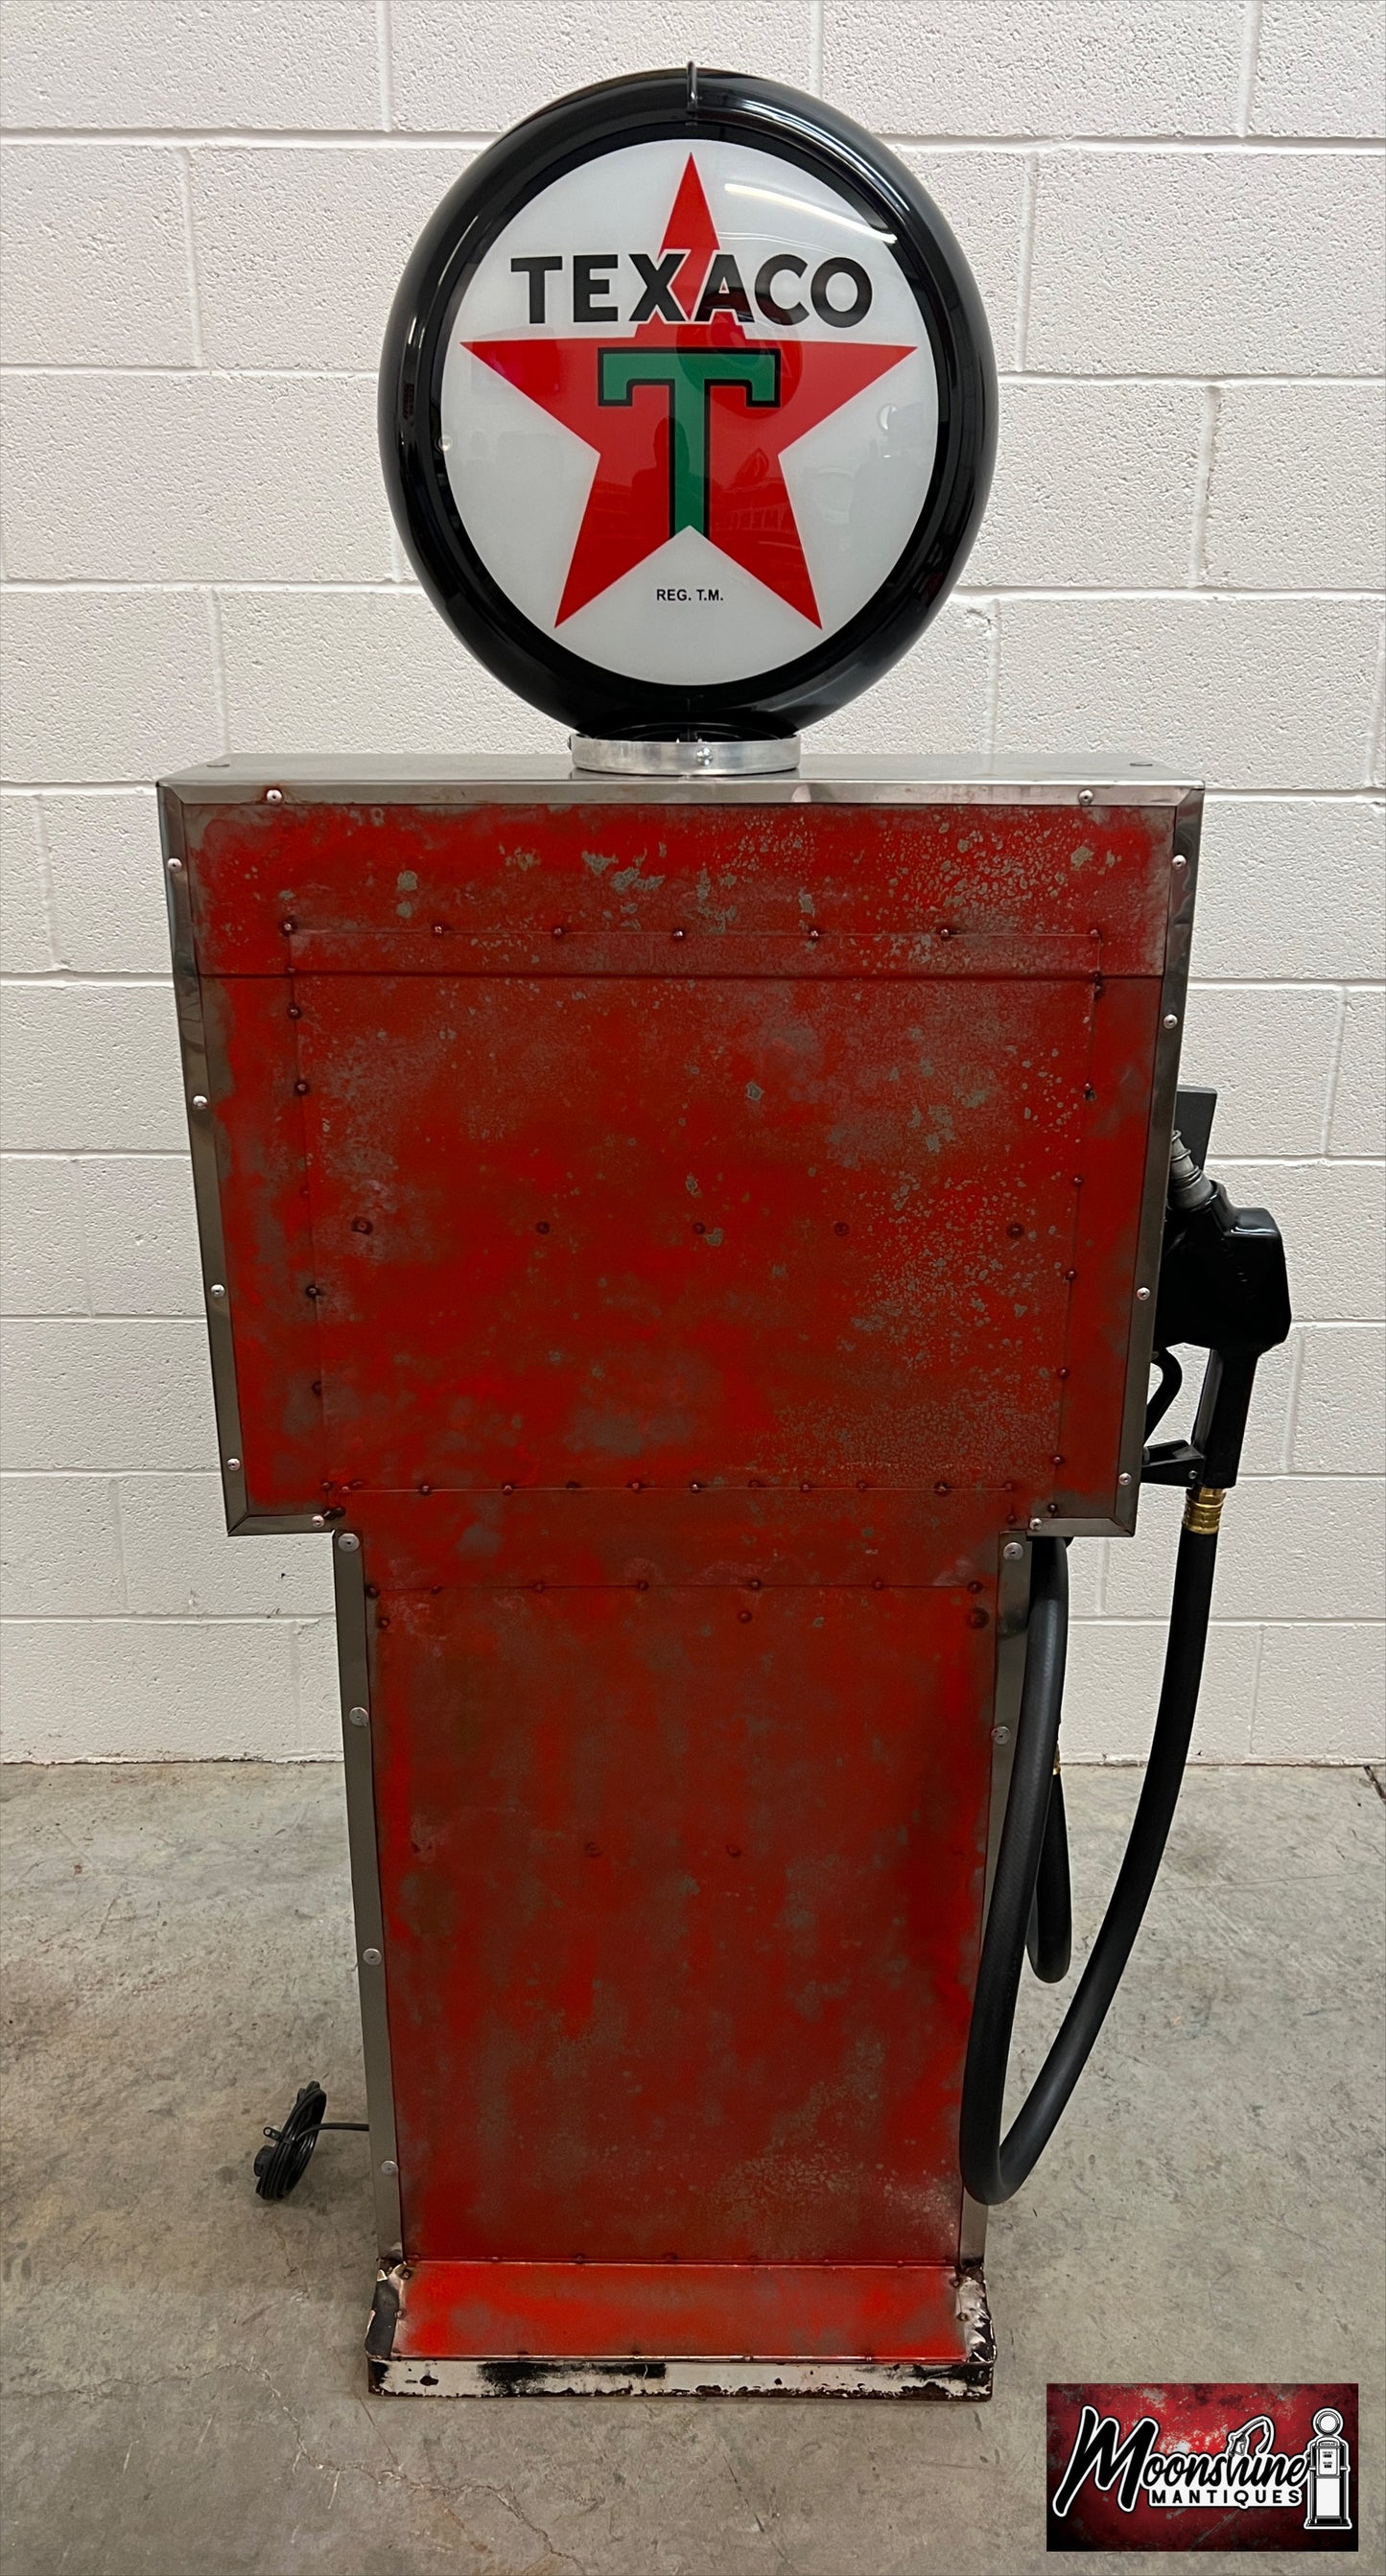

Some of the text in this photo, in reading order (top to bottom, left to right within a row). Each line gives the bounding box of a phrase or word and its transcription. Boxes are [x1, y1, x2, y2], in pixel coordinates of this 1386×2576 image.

[510, 253, 873, 329] TEXACO
[598, 346, 781, 538] T
[656, 588, 723, 601] REG. T.M.
